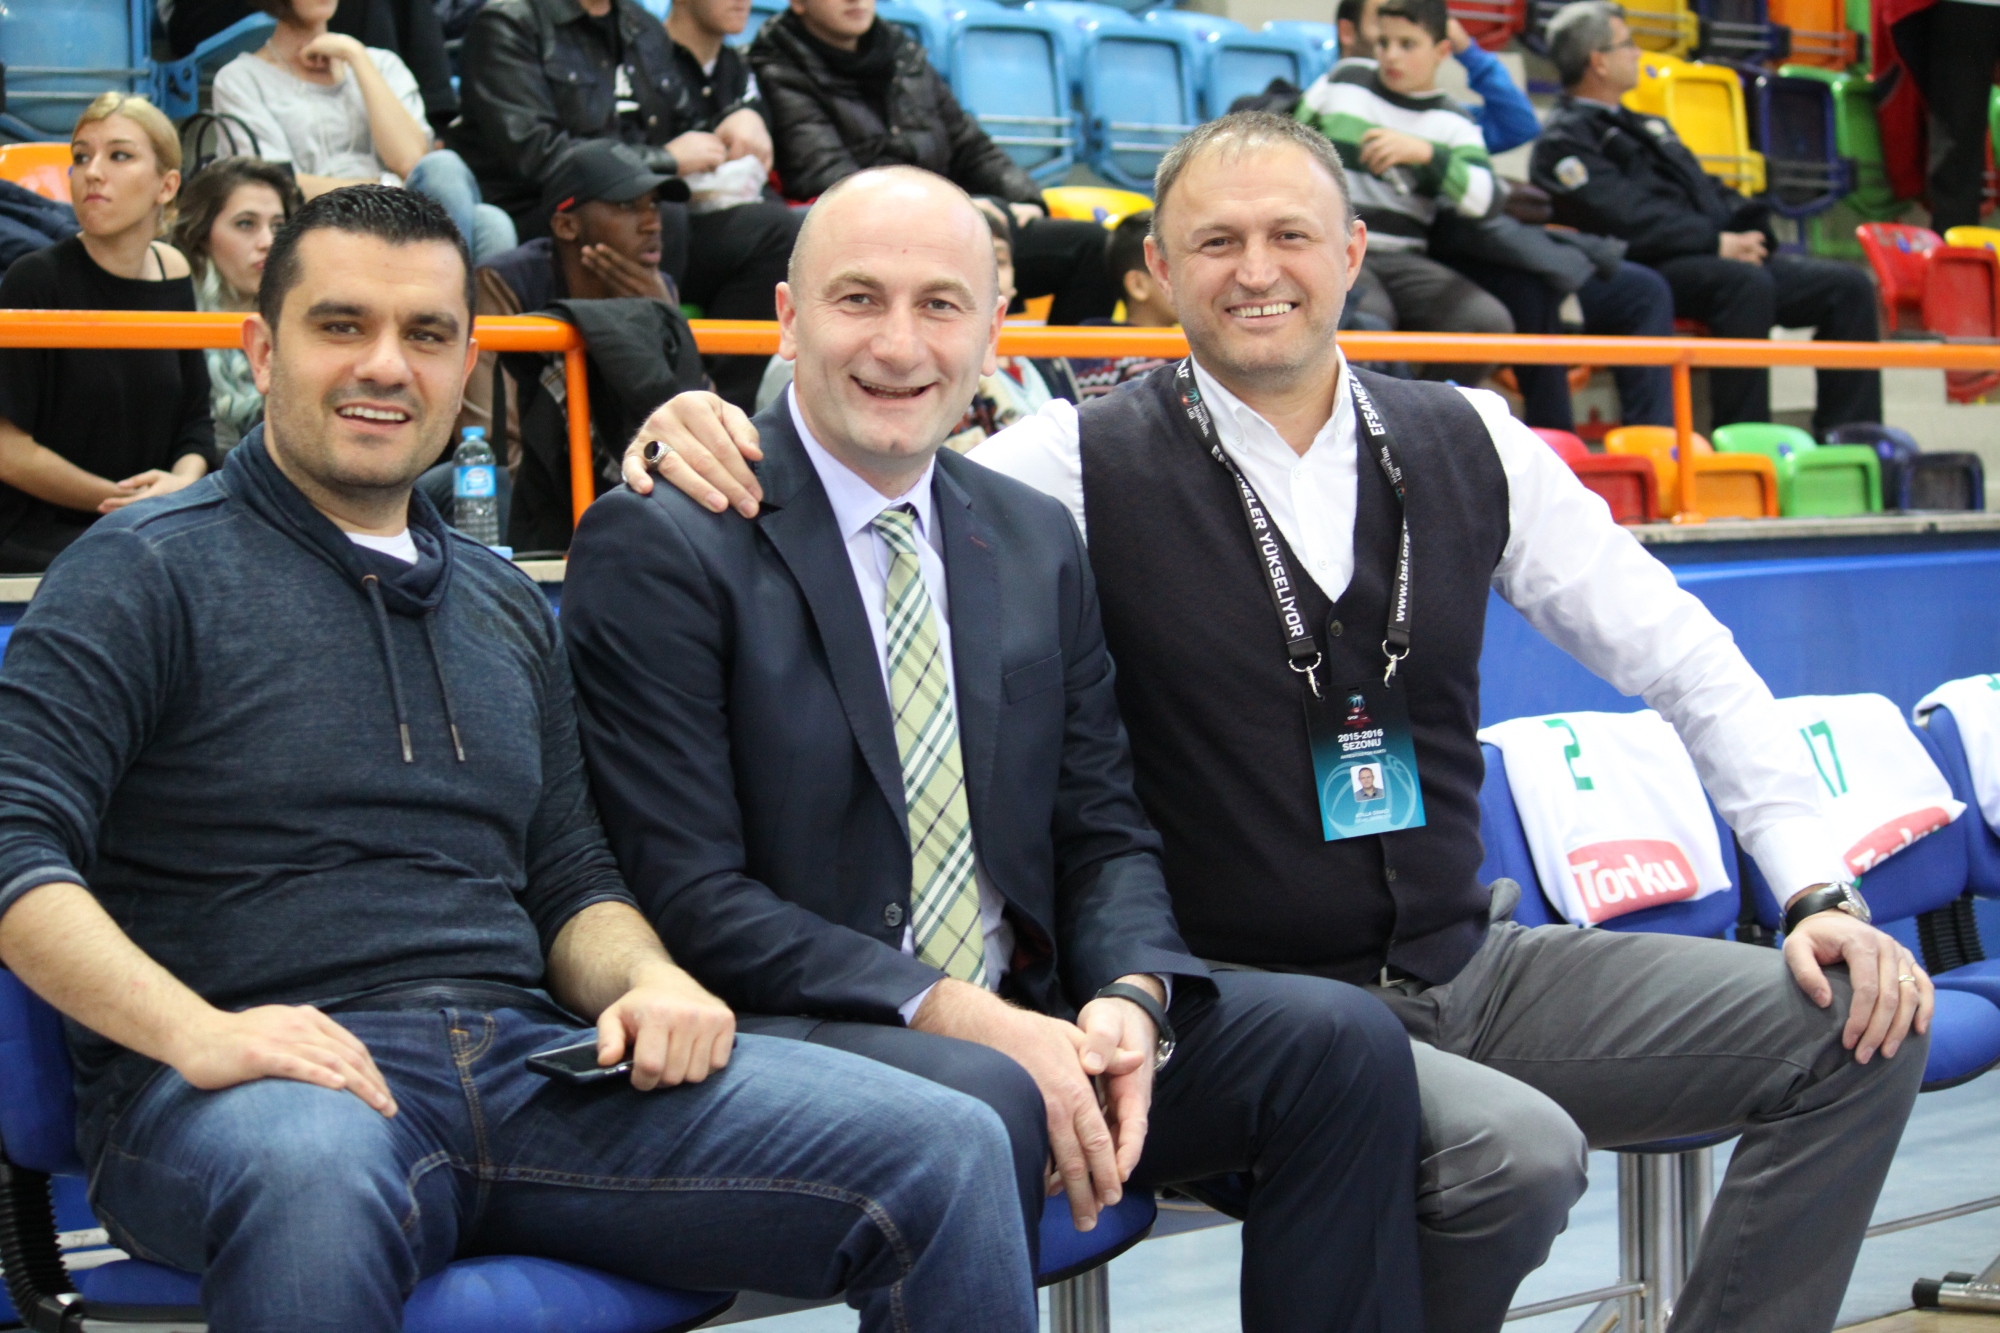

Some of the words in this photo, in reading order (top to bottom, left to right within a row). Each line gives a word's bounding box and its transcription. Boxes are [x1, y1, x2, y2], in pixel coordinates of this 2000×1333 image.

[1259, 531, 1305, 639] YÜKSELİYOR
[1337, 728, 1384, 743] 2015-2016
[1342, 737, 1382, 751] SEZONU
[1542, 718, 1595, 790] 2
[1571, 853, 1688, 909] Torku
